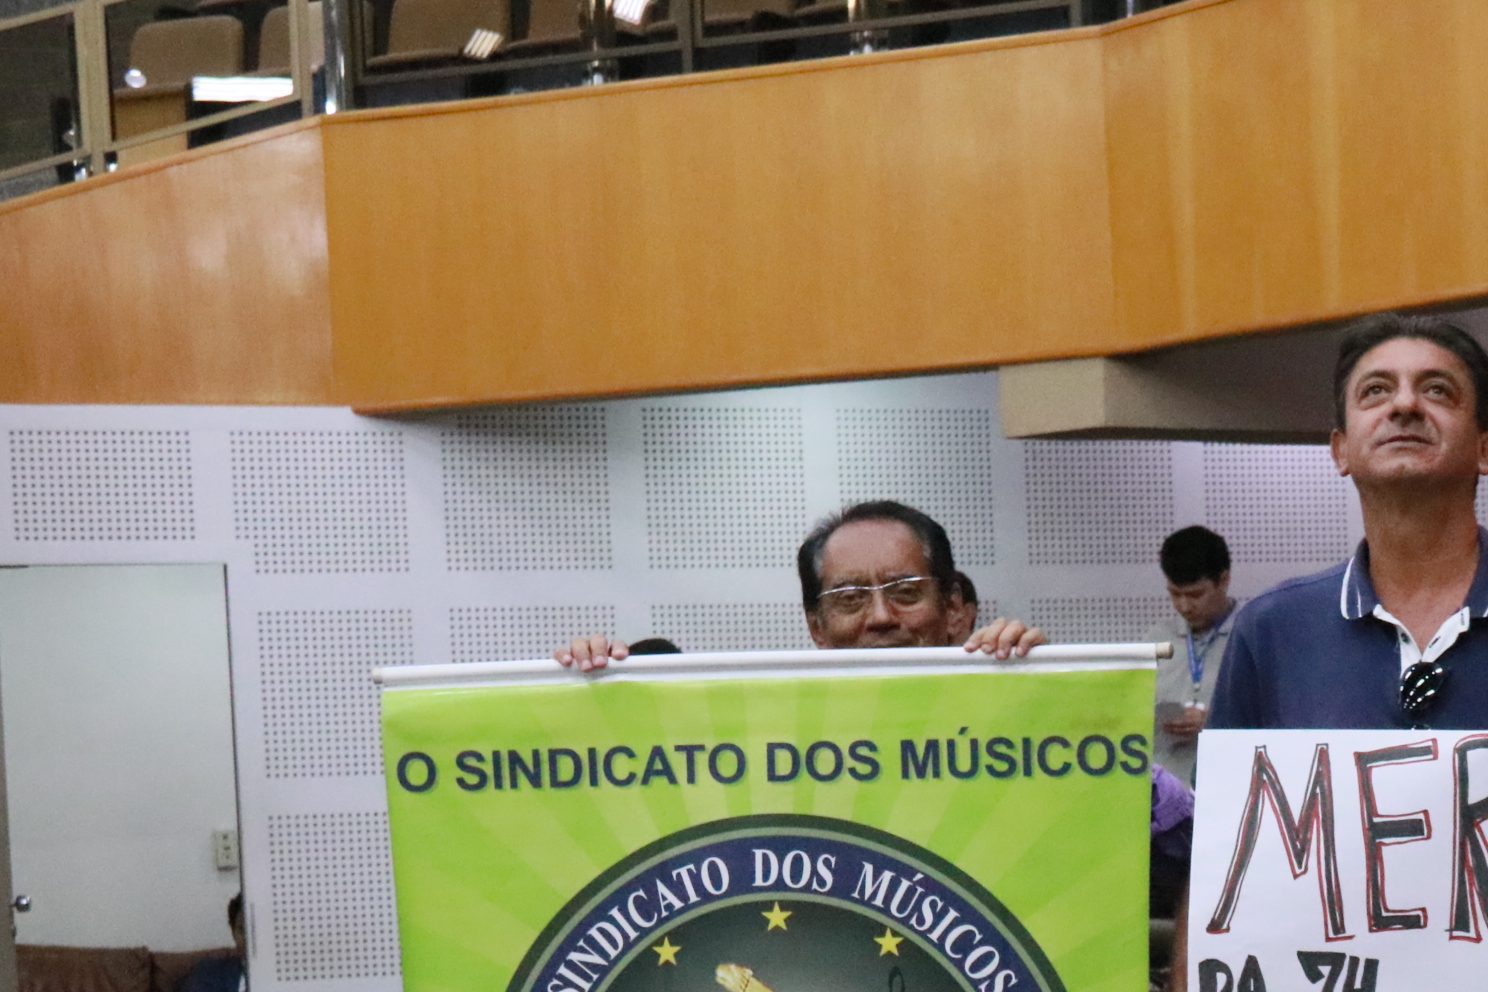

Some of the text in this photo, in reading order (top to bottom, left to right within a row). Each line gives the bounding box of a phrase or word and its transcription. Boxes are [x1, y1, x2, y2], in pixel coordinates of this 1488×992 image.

[396, 727, 1149, 792] O SINDICATO DOS MÚSICOS
[752, 849, 836, 893] DOS
